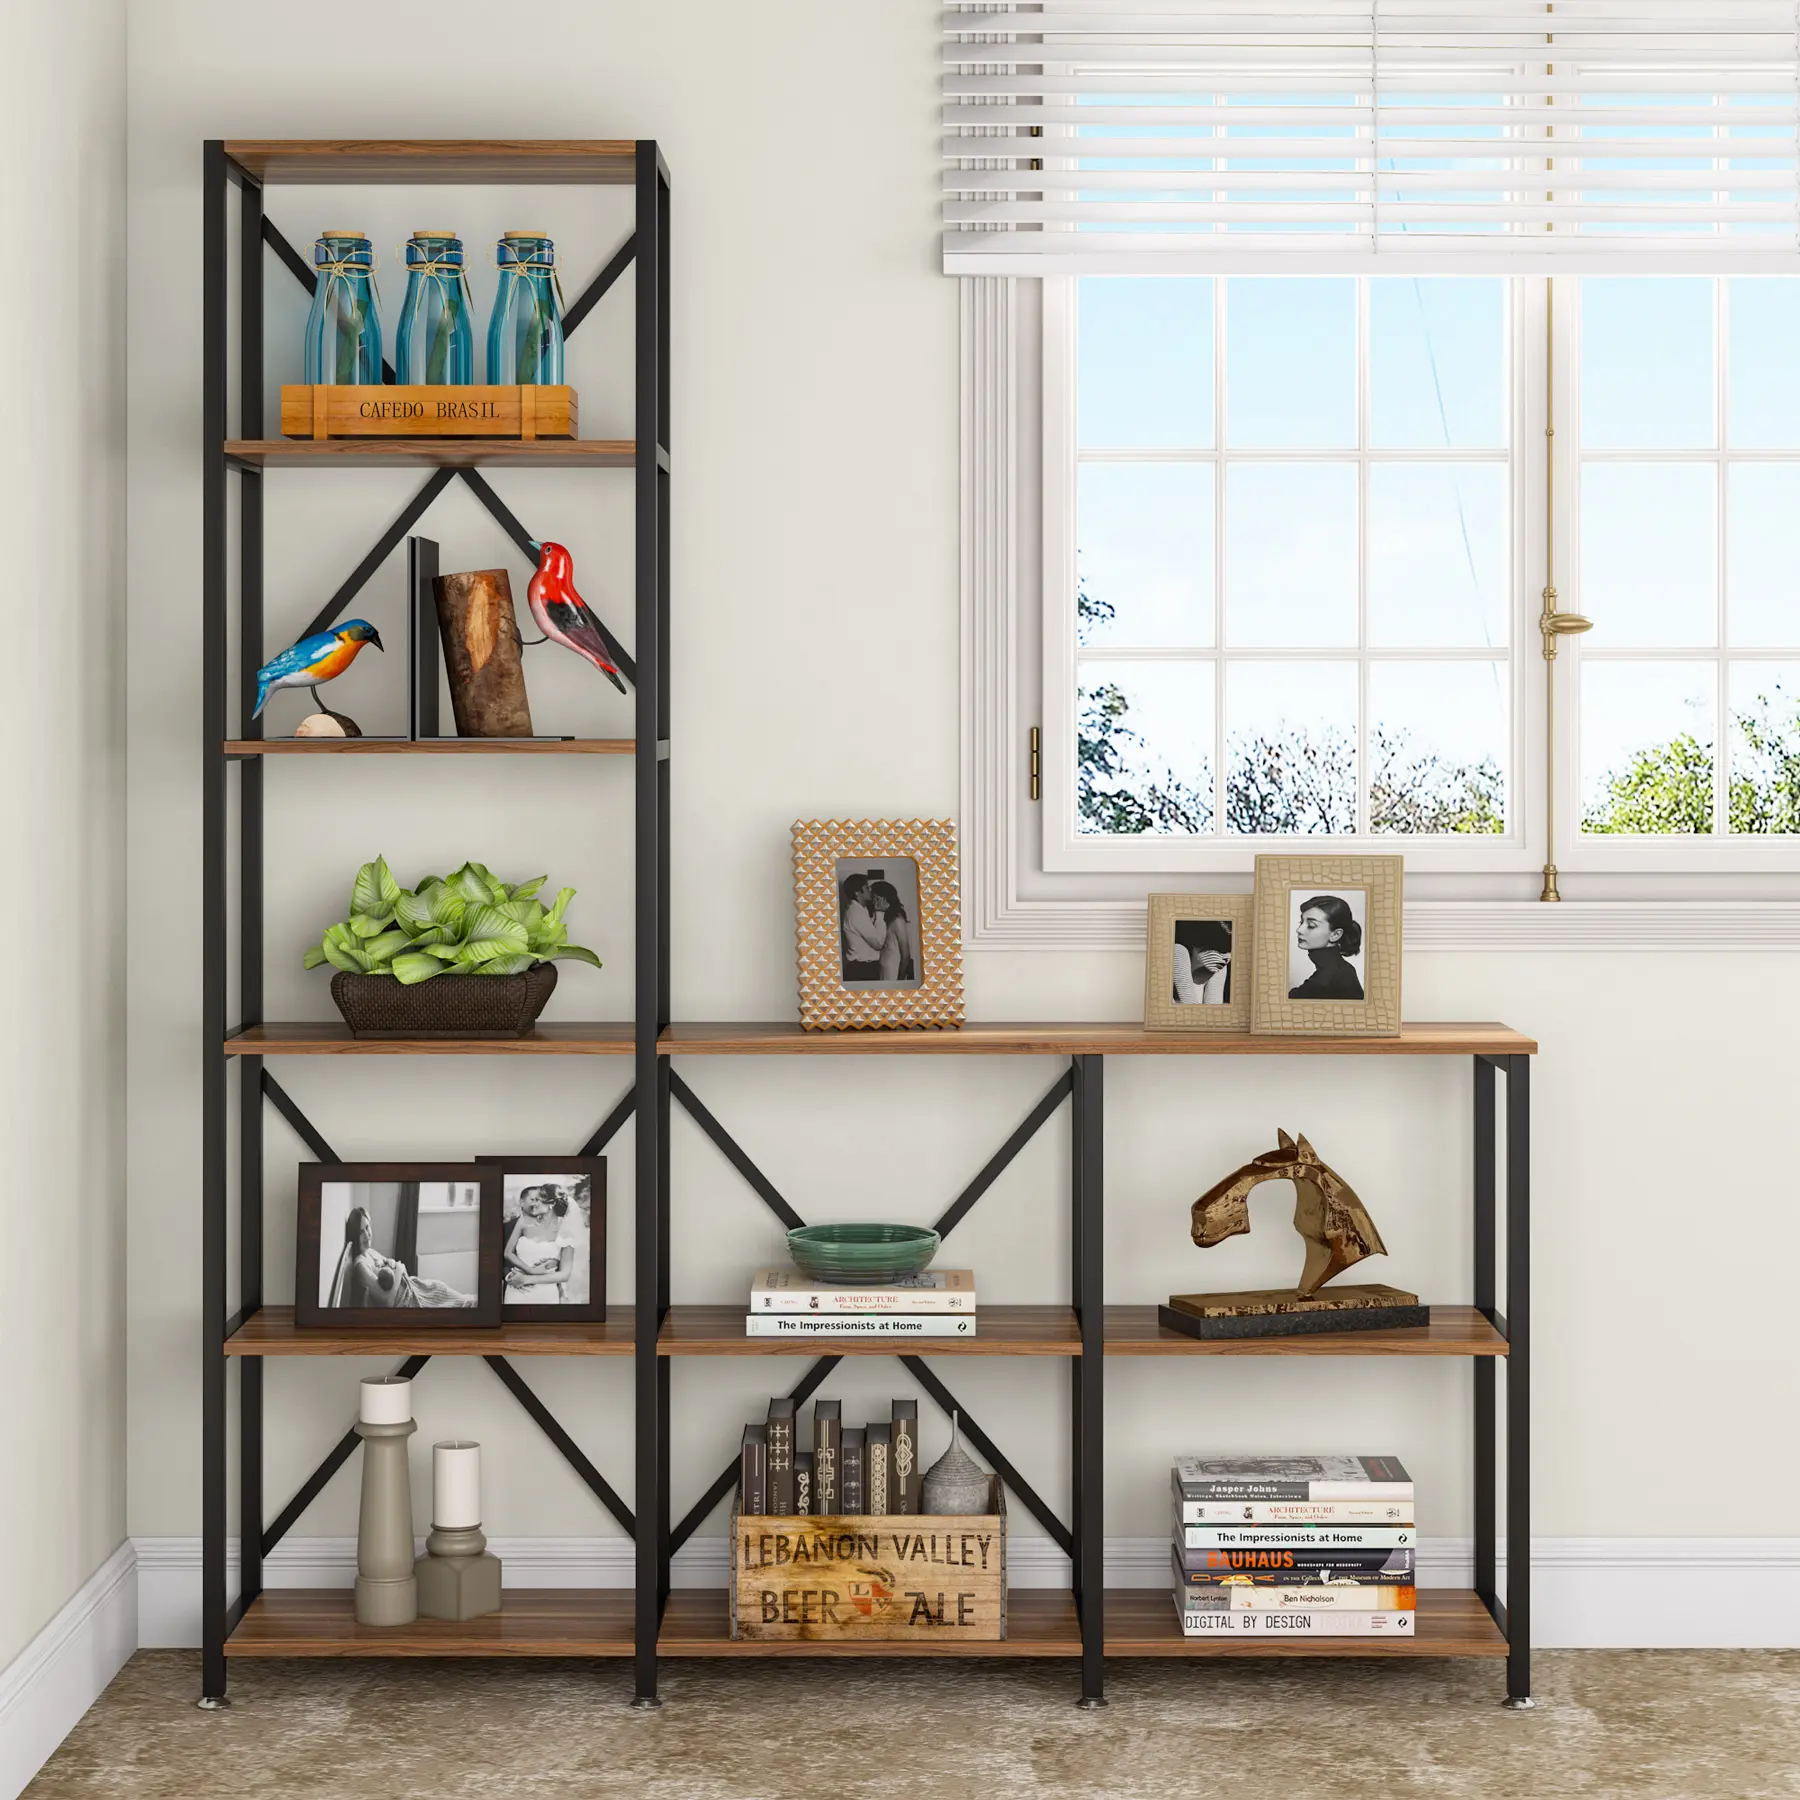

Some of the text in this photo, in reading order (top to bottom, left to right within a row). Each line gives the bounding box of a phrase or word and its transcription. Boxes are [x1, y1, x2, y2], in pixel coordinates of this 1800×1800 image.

[360, 402, 500, 418] CAFEDO BRASIL
[778, 1321, 923, 1332] The Impressionists at Home
[1210, 1485, 1278, 1494] Jasper Johns
[1217, 1533, 1363, 1544] The Impressionists at Home
[744, 1534, 992, 1570] LEBANON VALLEY
[1207, 1551, 1294, 1568] BAUHAUS
[853, 1584, 869, 1595] L
[1284, 1594, 1335, 1603] Ben Nicholson
[761, 1590, 840, 1624] BEER
[904, 1592, 976, 1626] ALE
[1185, 1616, 1311, 1629] DIGITAL BY DESIGN
